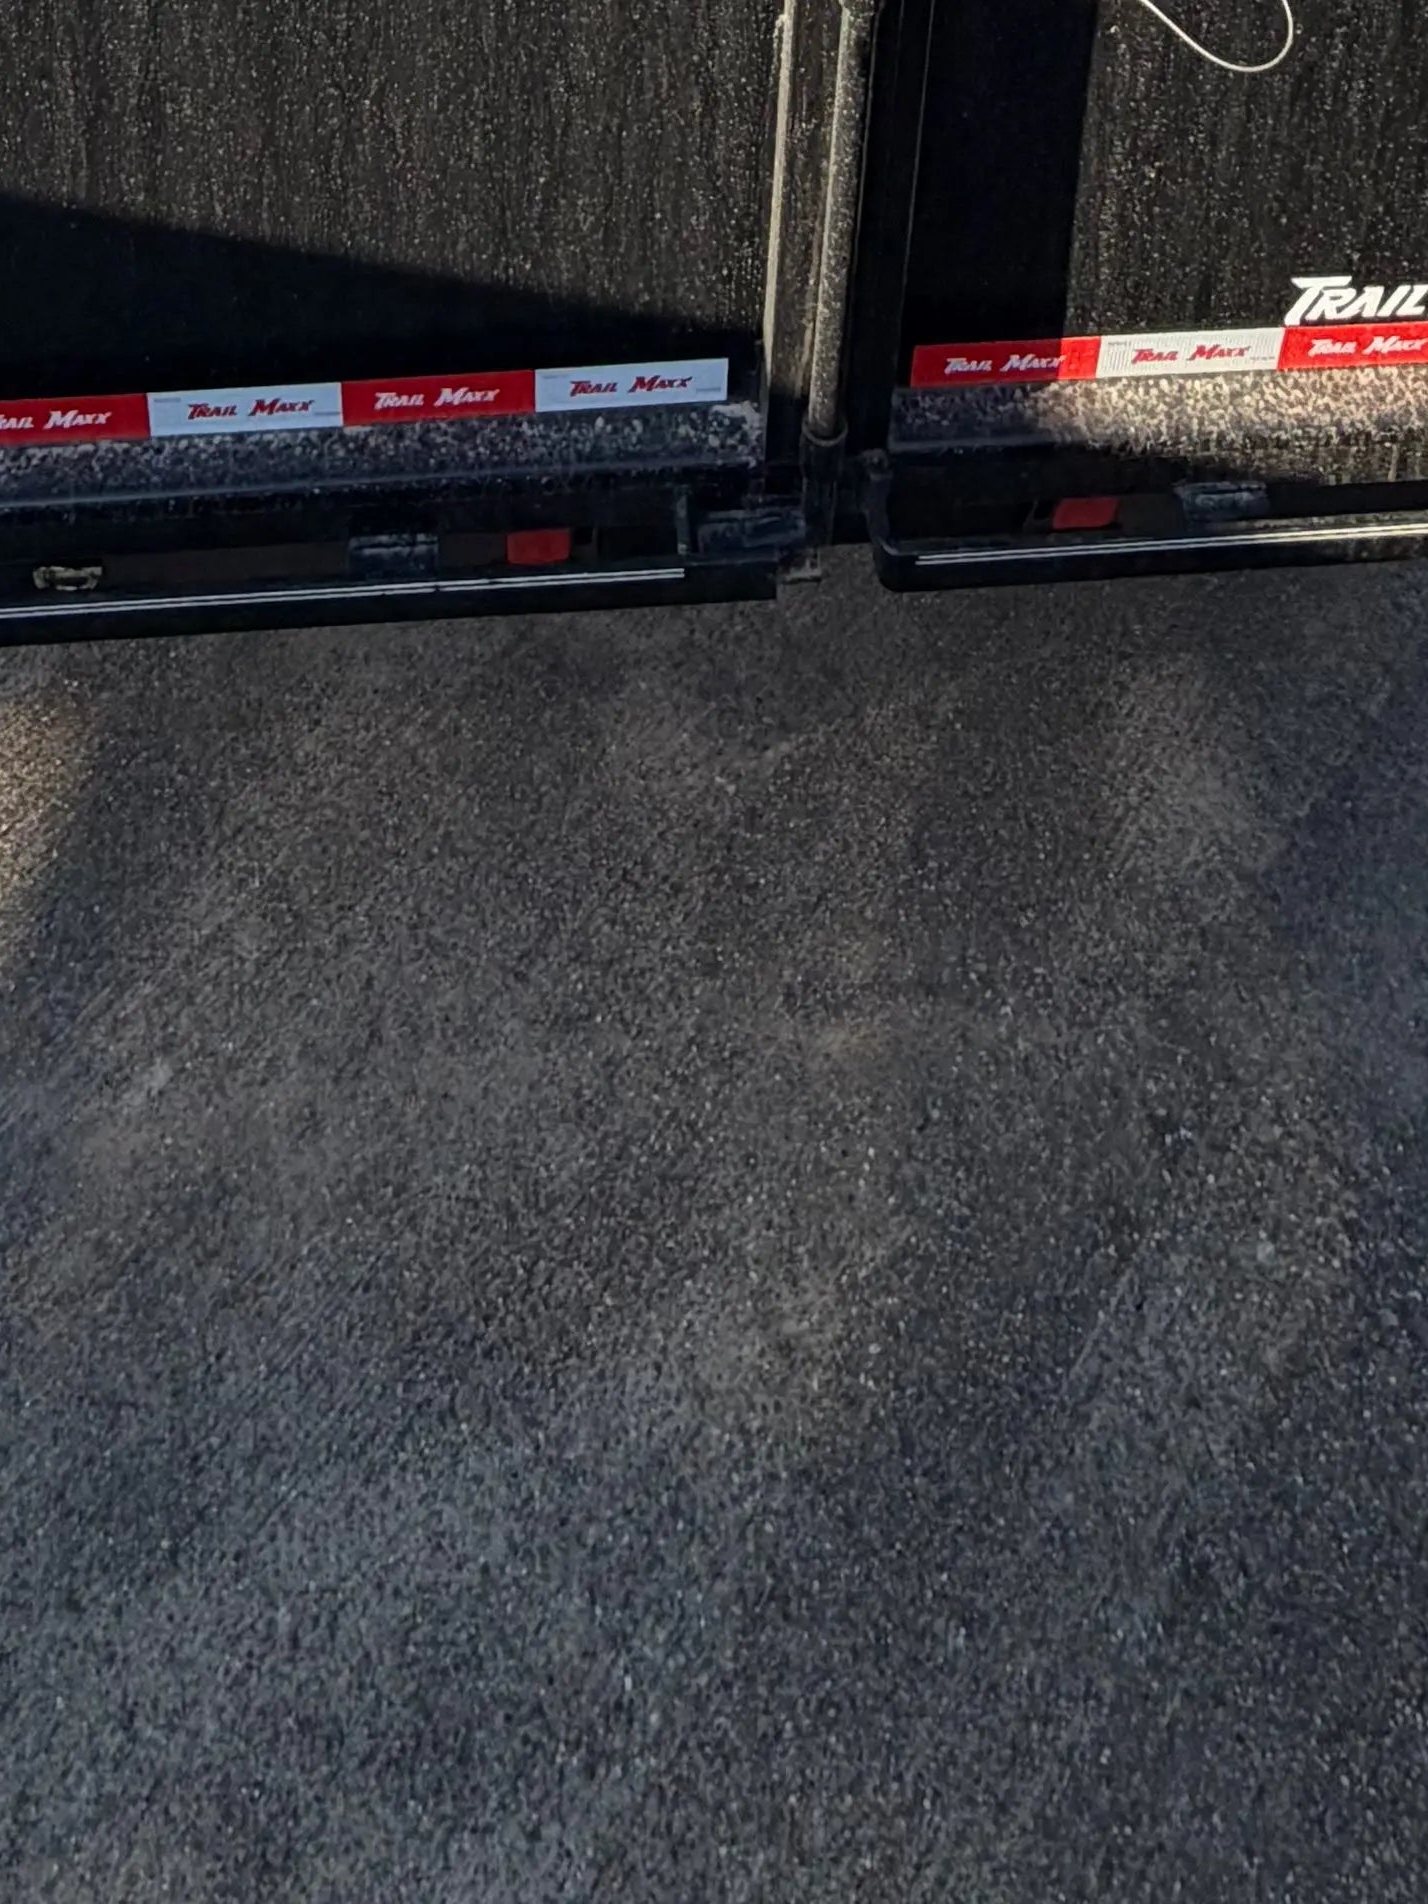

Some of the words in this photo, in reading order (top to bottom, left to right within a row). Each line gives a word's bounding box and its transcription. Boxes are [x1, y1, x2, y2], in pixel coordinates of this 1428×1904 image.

[1131, 348, 1179, 364] TRAIL
[1308, 338, 1357, 357] TRAIL
[943, 357, 993, 375] TRAIL
[569, 380, 619, 398] TRAIL
[374, 391, 425, 410] TRAIL
[186, 403, 238, 420] TRAIL
